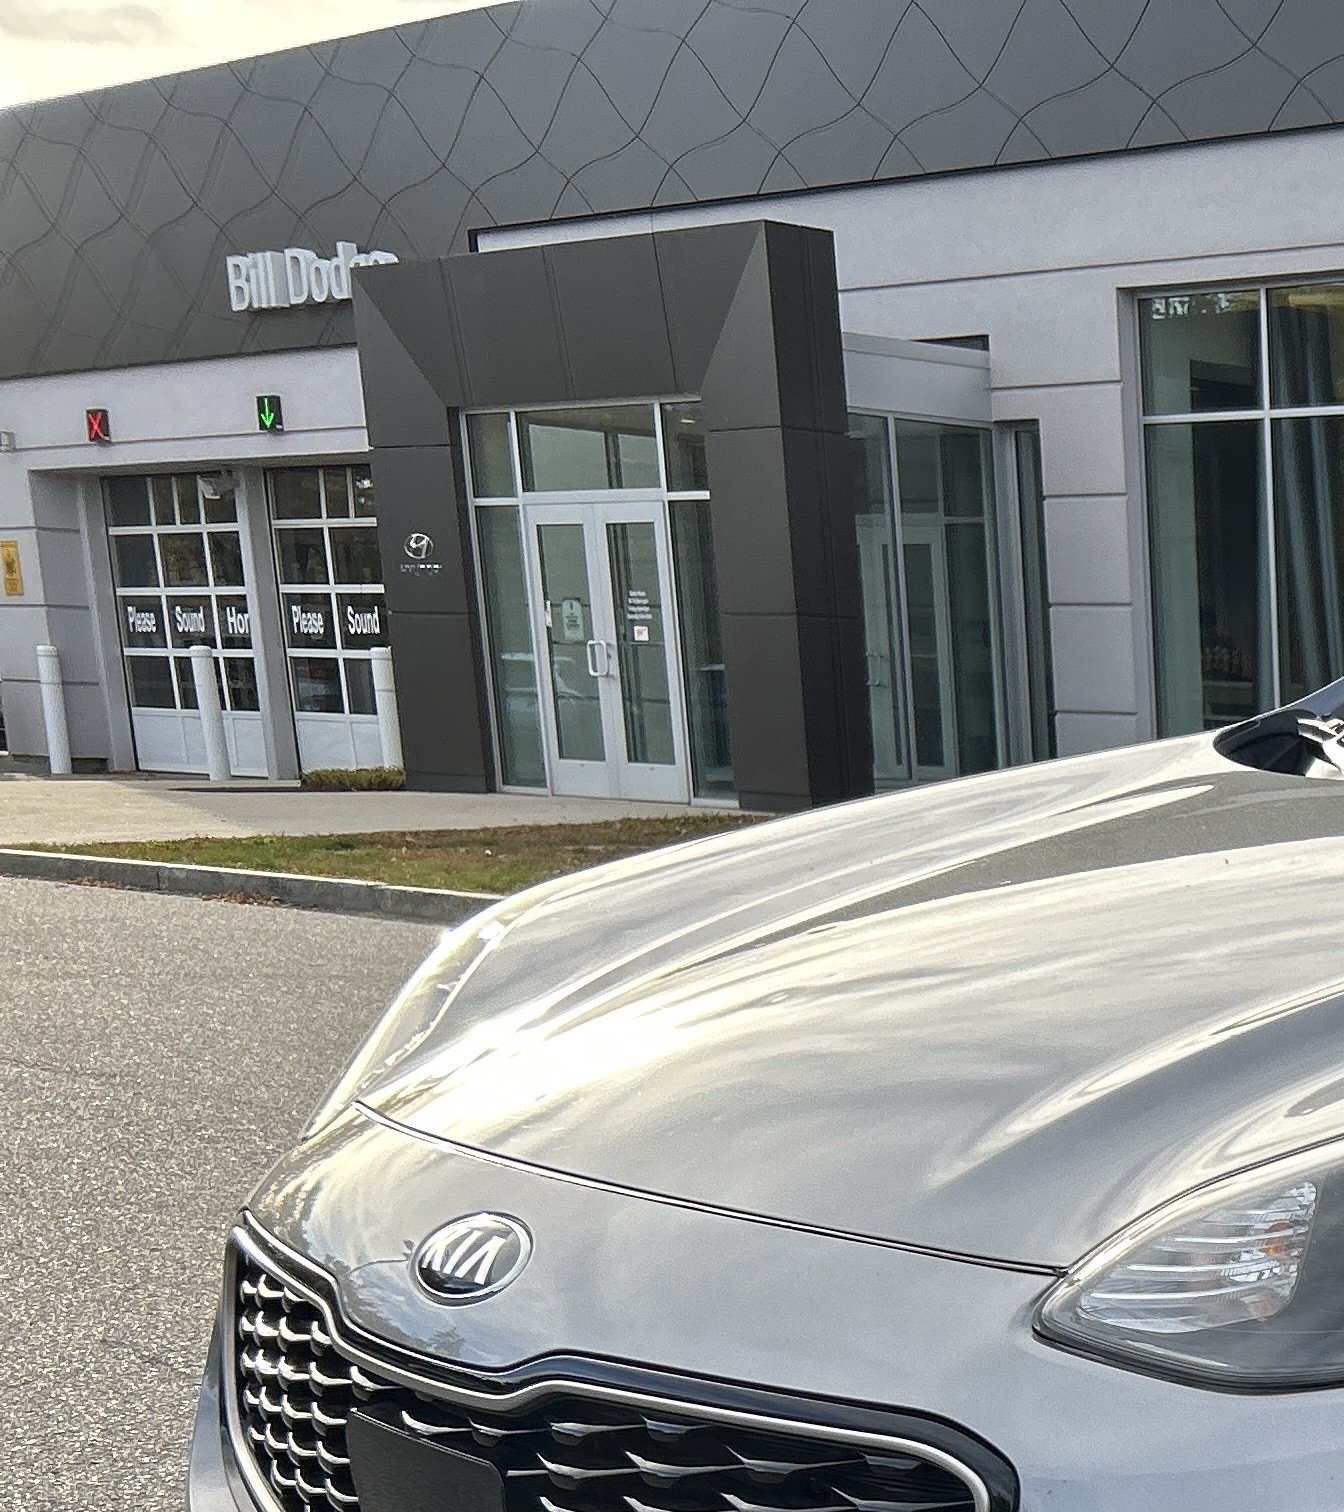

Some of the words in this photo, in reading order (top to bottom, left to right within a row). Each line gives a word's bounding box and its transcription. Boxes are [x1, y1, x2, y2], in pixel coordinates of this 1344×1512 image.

[226, 253, 288, 312] Bill
[284, 241, 399, 304] Dod
[127, 605, 157, 633] Please
[175, 605, 205, 633] Sound
[226, 606, 249, 634] Hor
[291, 605, 324, 634] Please
[347, 605, 380, 635] Sound
[419, 1227, 507, 1285] KIA
